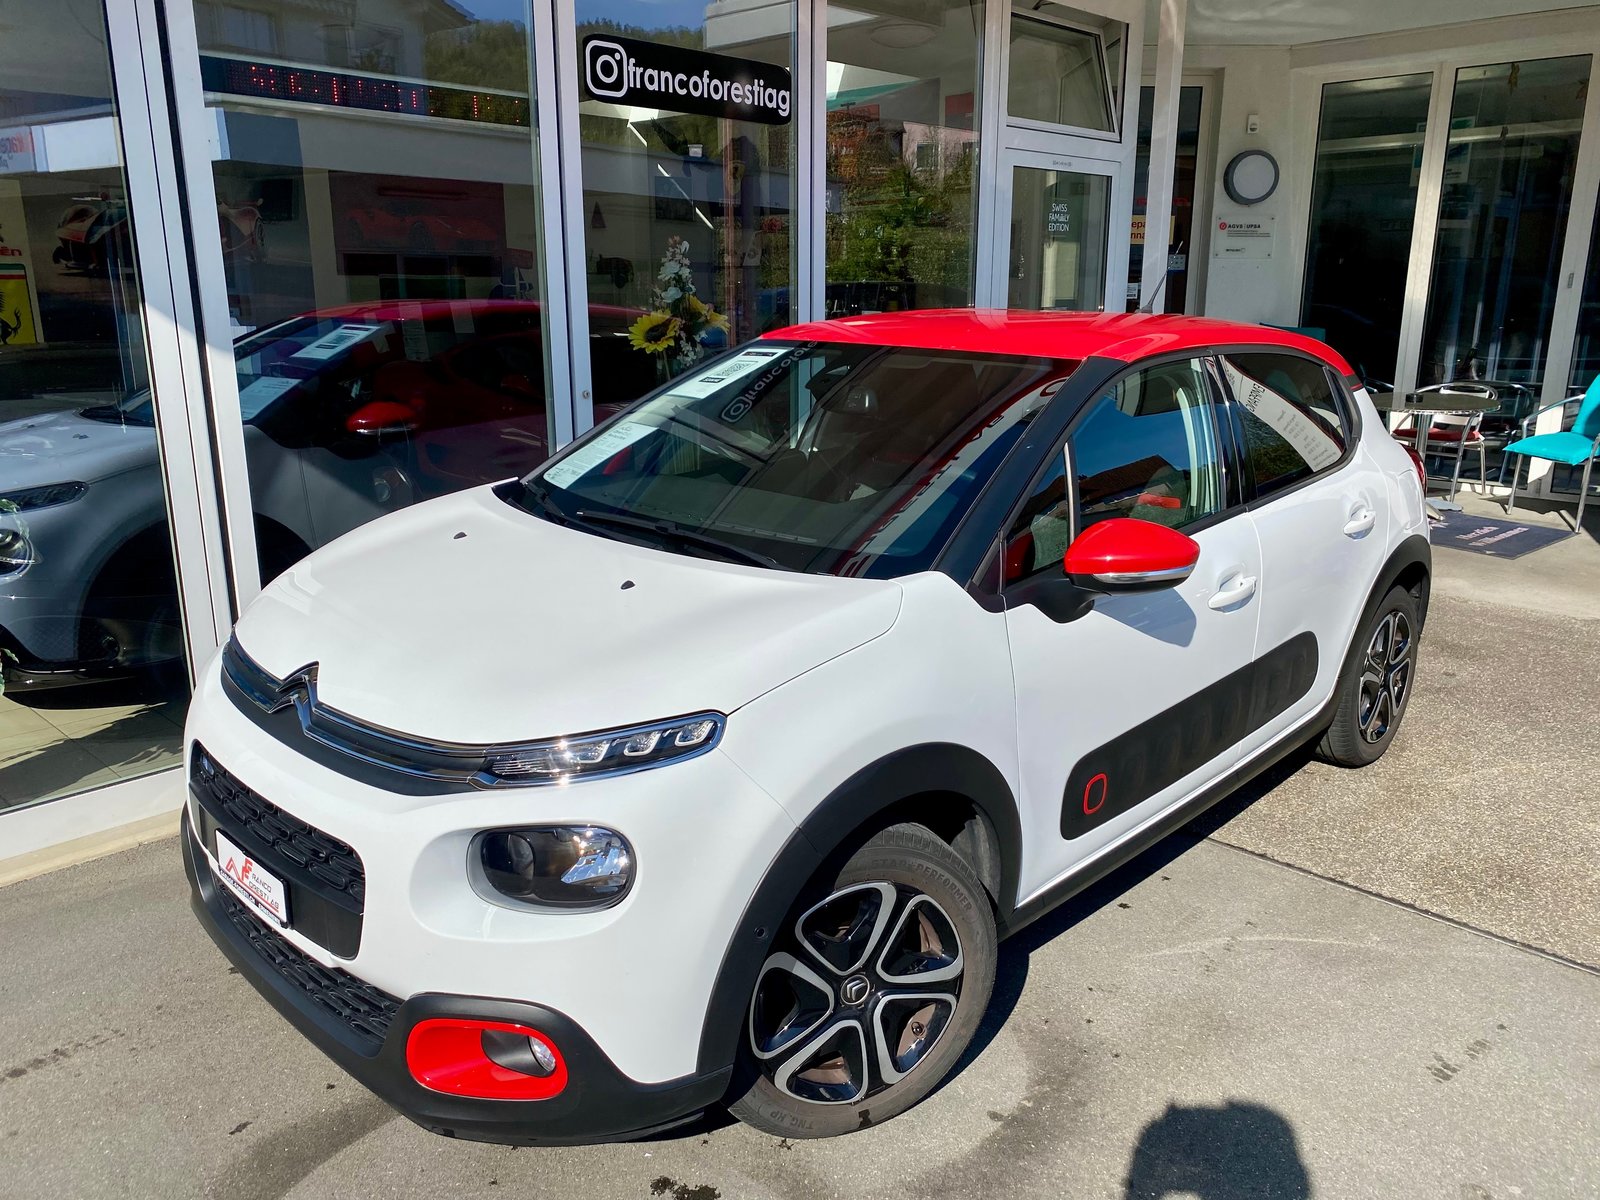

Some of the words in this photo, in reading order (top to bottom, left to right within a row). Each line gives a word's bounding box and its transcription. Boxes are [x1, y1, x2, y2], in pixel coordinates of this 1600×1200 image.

[628, 57, 790, 117] francoforestiag
[1052, 203, 1068, 212] SWISS
[1049, 223, 1069, 232] EDITION
[915, 862, 974, 911] PERFORMER
